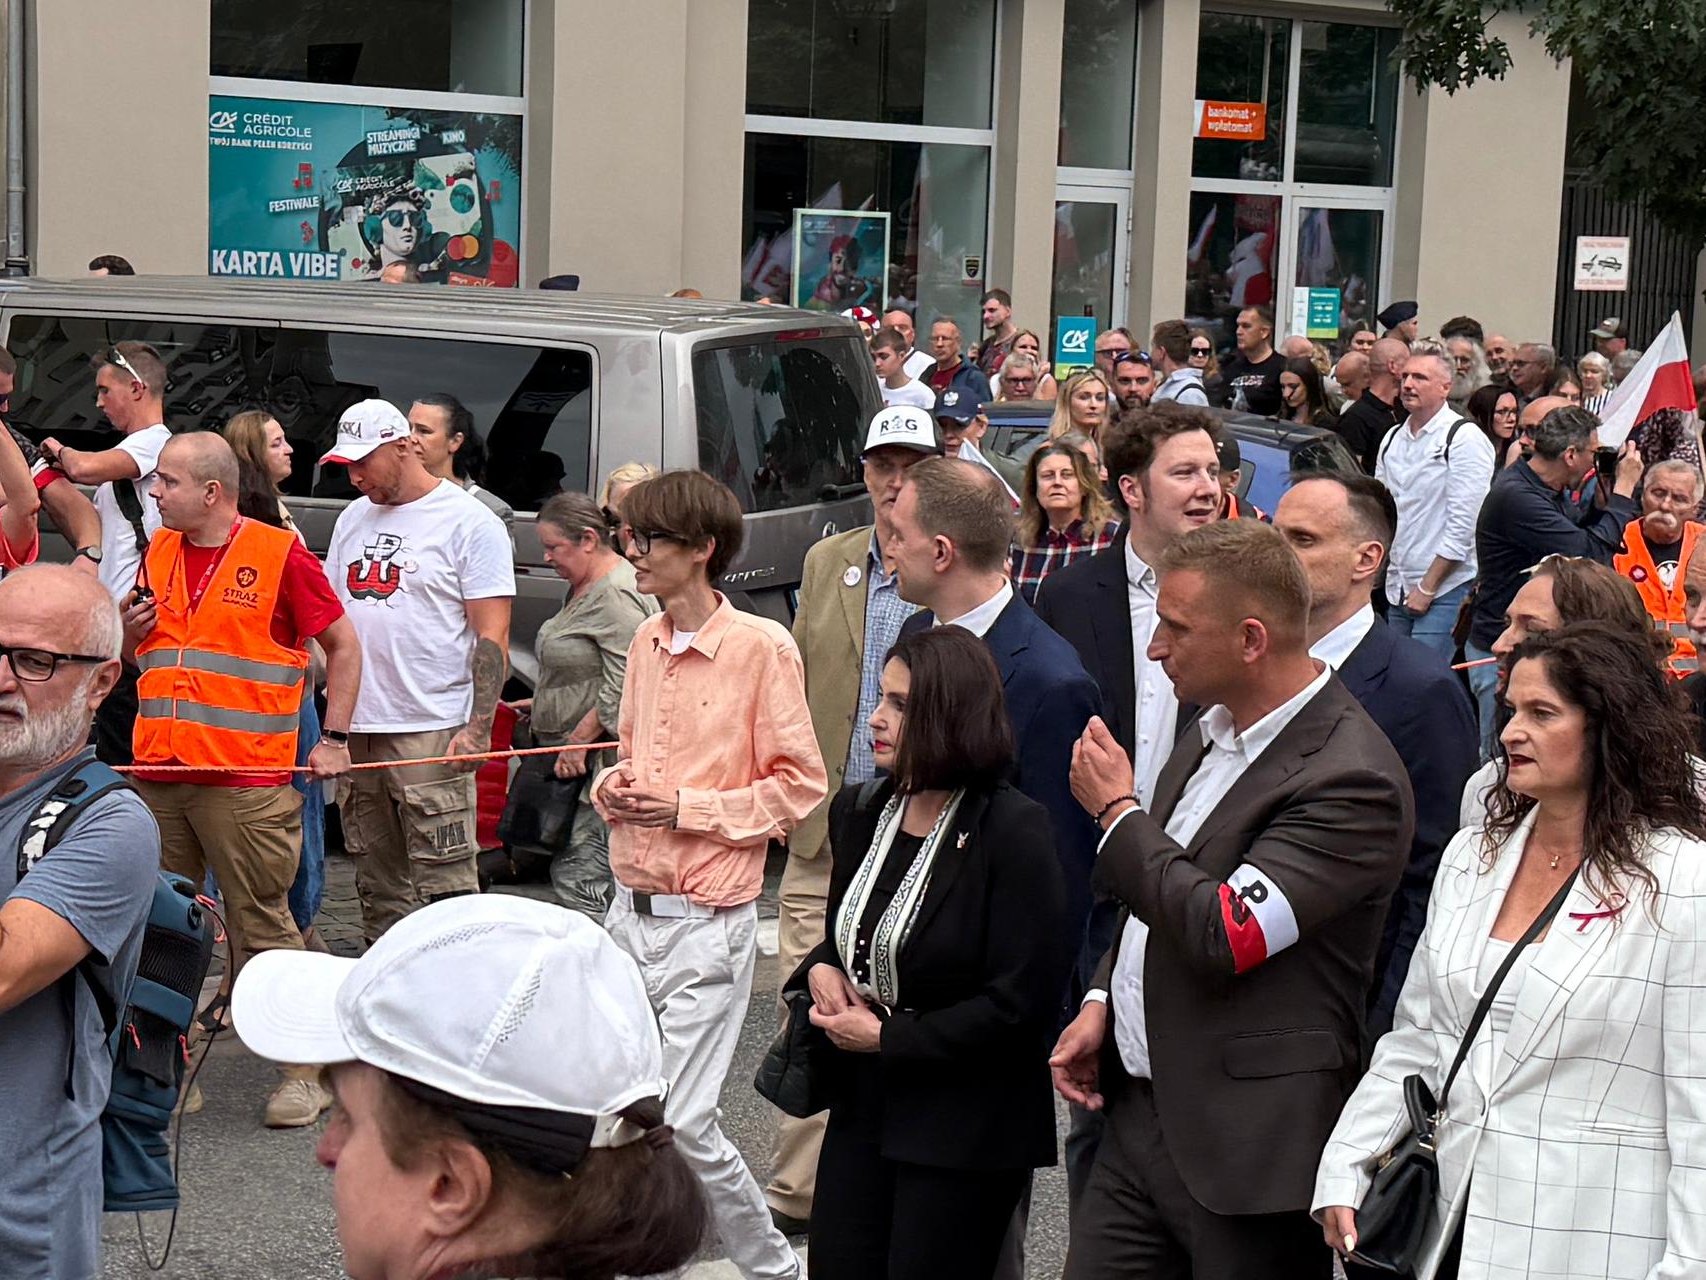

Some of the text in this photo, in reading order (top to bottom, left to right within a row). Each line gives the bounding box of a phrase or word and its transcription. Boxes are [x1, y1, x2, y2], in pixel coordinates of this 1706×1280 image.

[243, 112, 293, 126] CRÉDIT
[243, 124, 312, 138] AGRICOLE
[368, 140, 416, 156] MUZYCZNE
[269, 196, 320, 213] FESTIWALE
[212, 250, 338, 277] KARTA VIBE
